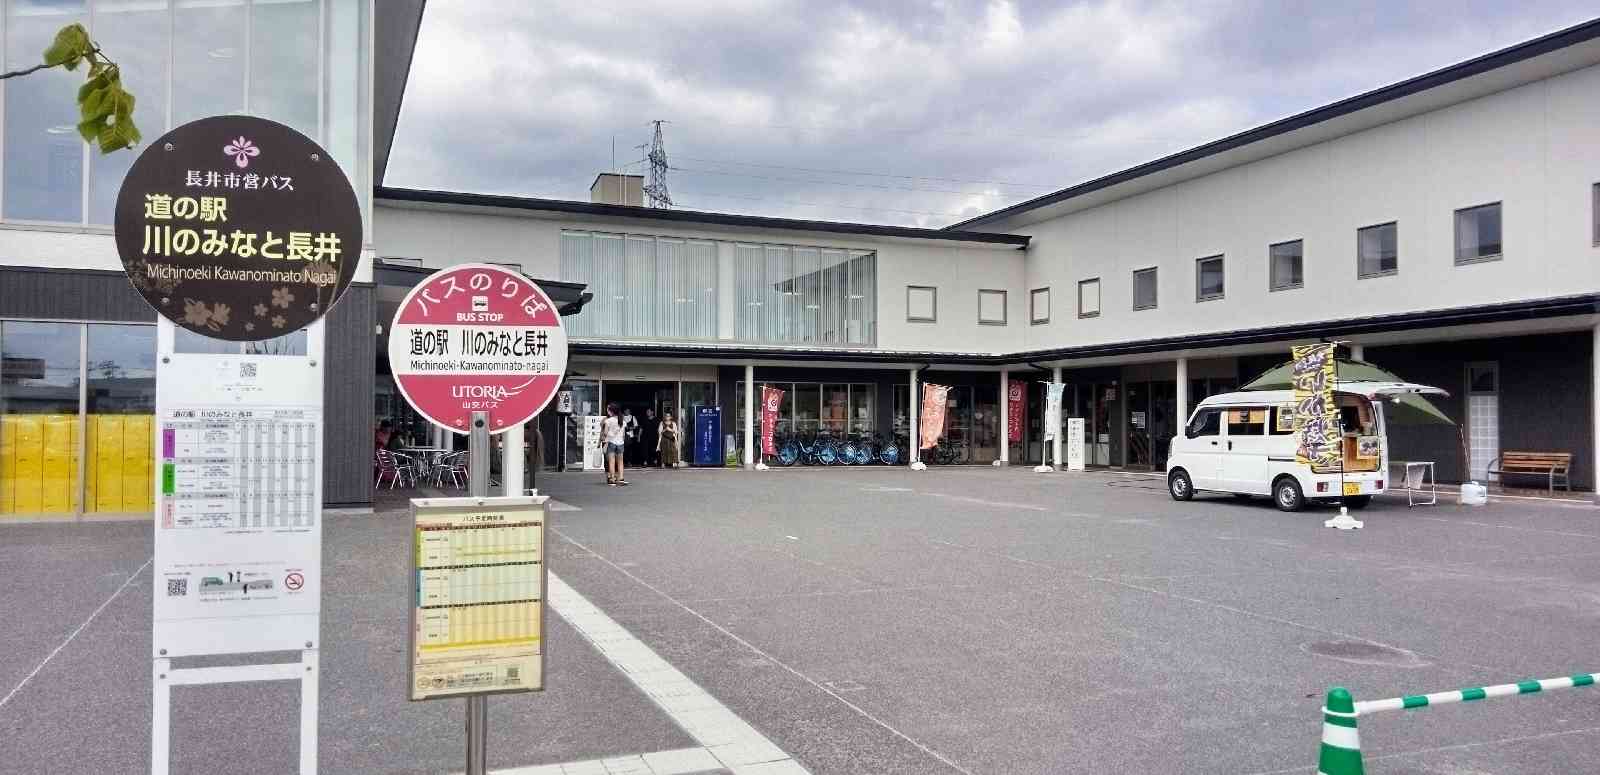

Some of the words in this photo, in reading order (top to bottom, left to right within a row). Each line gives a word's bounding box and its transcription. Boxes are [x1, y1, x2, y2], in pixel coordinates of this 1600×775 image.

[185, 169, 294, 191] 長井市営バス
[144, 193, 228, 222] 道の駅
[142, 225, 342, 262] 川のみなと長井
[147, 264, 212, 280] Michinoeki
[214, 266, 301, 283] Kawanominato
[303, 270, 337, 287] Nagai
[416, 273, 548, 318] バスのりば
[456, 312, 476, 322] BUS
[479, 312, 504, 322] STOP
[410, 329, 449, 356] 道の駅
[462, 329, 548, 356] 川のみなと長井
[452, 385, 508, 399] UTORIA
[462, 400, 499, 409] 山交バス
